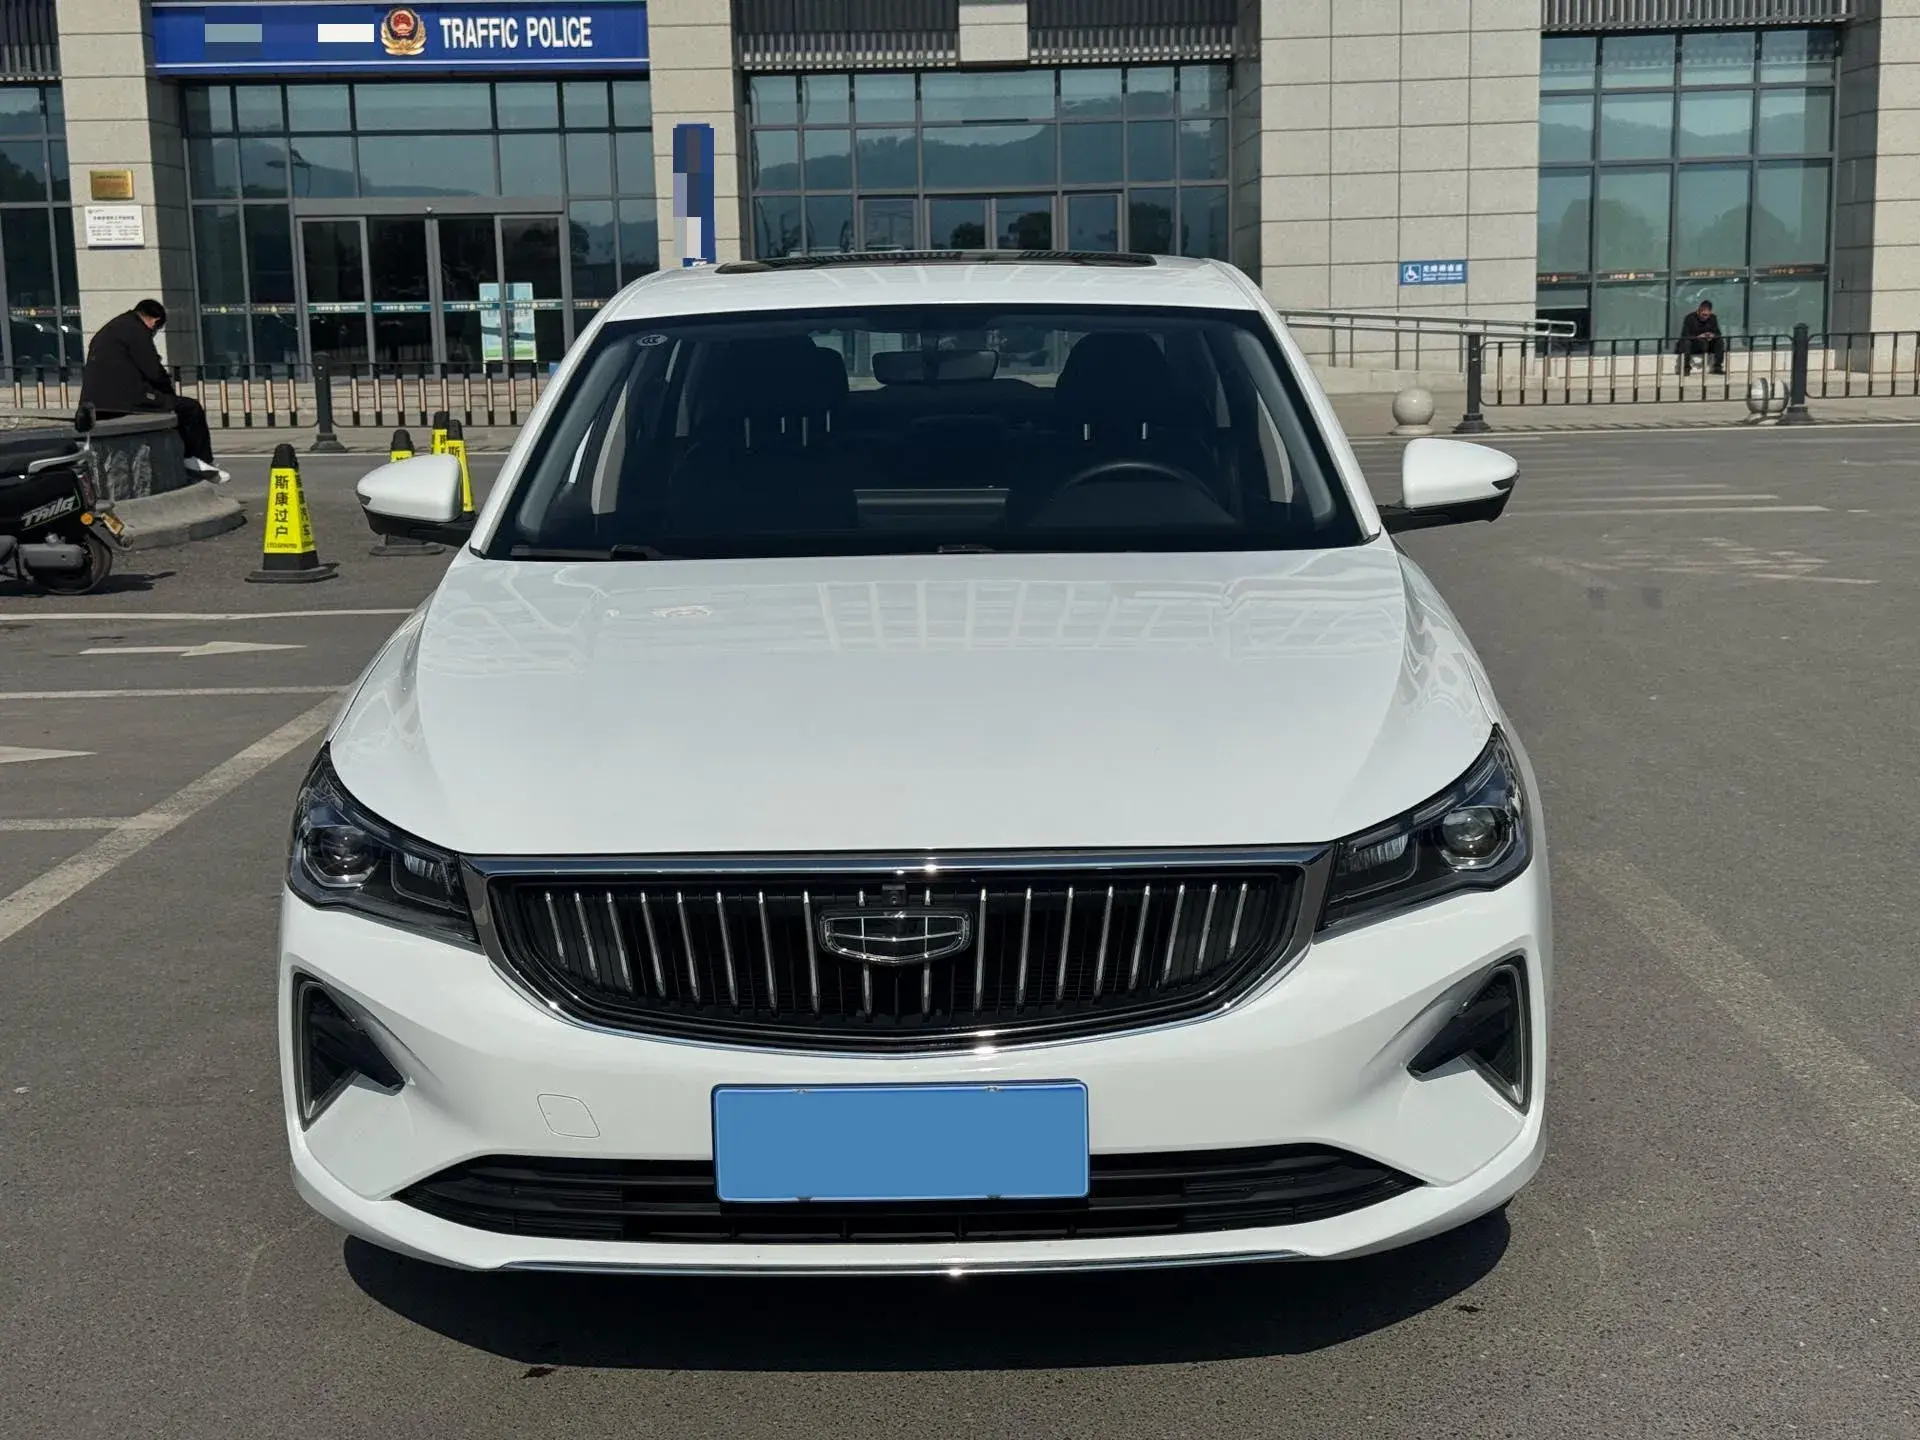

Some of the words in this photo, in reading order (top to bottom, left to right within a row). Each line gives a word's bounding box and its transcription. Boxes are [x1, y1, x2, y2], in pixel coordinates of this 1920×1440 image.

[439, 16, 518, 49] TRAFFIC
[526, 16, 593, 48] POLICE
[274, 475, 289, 539] 斯康过户
